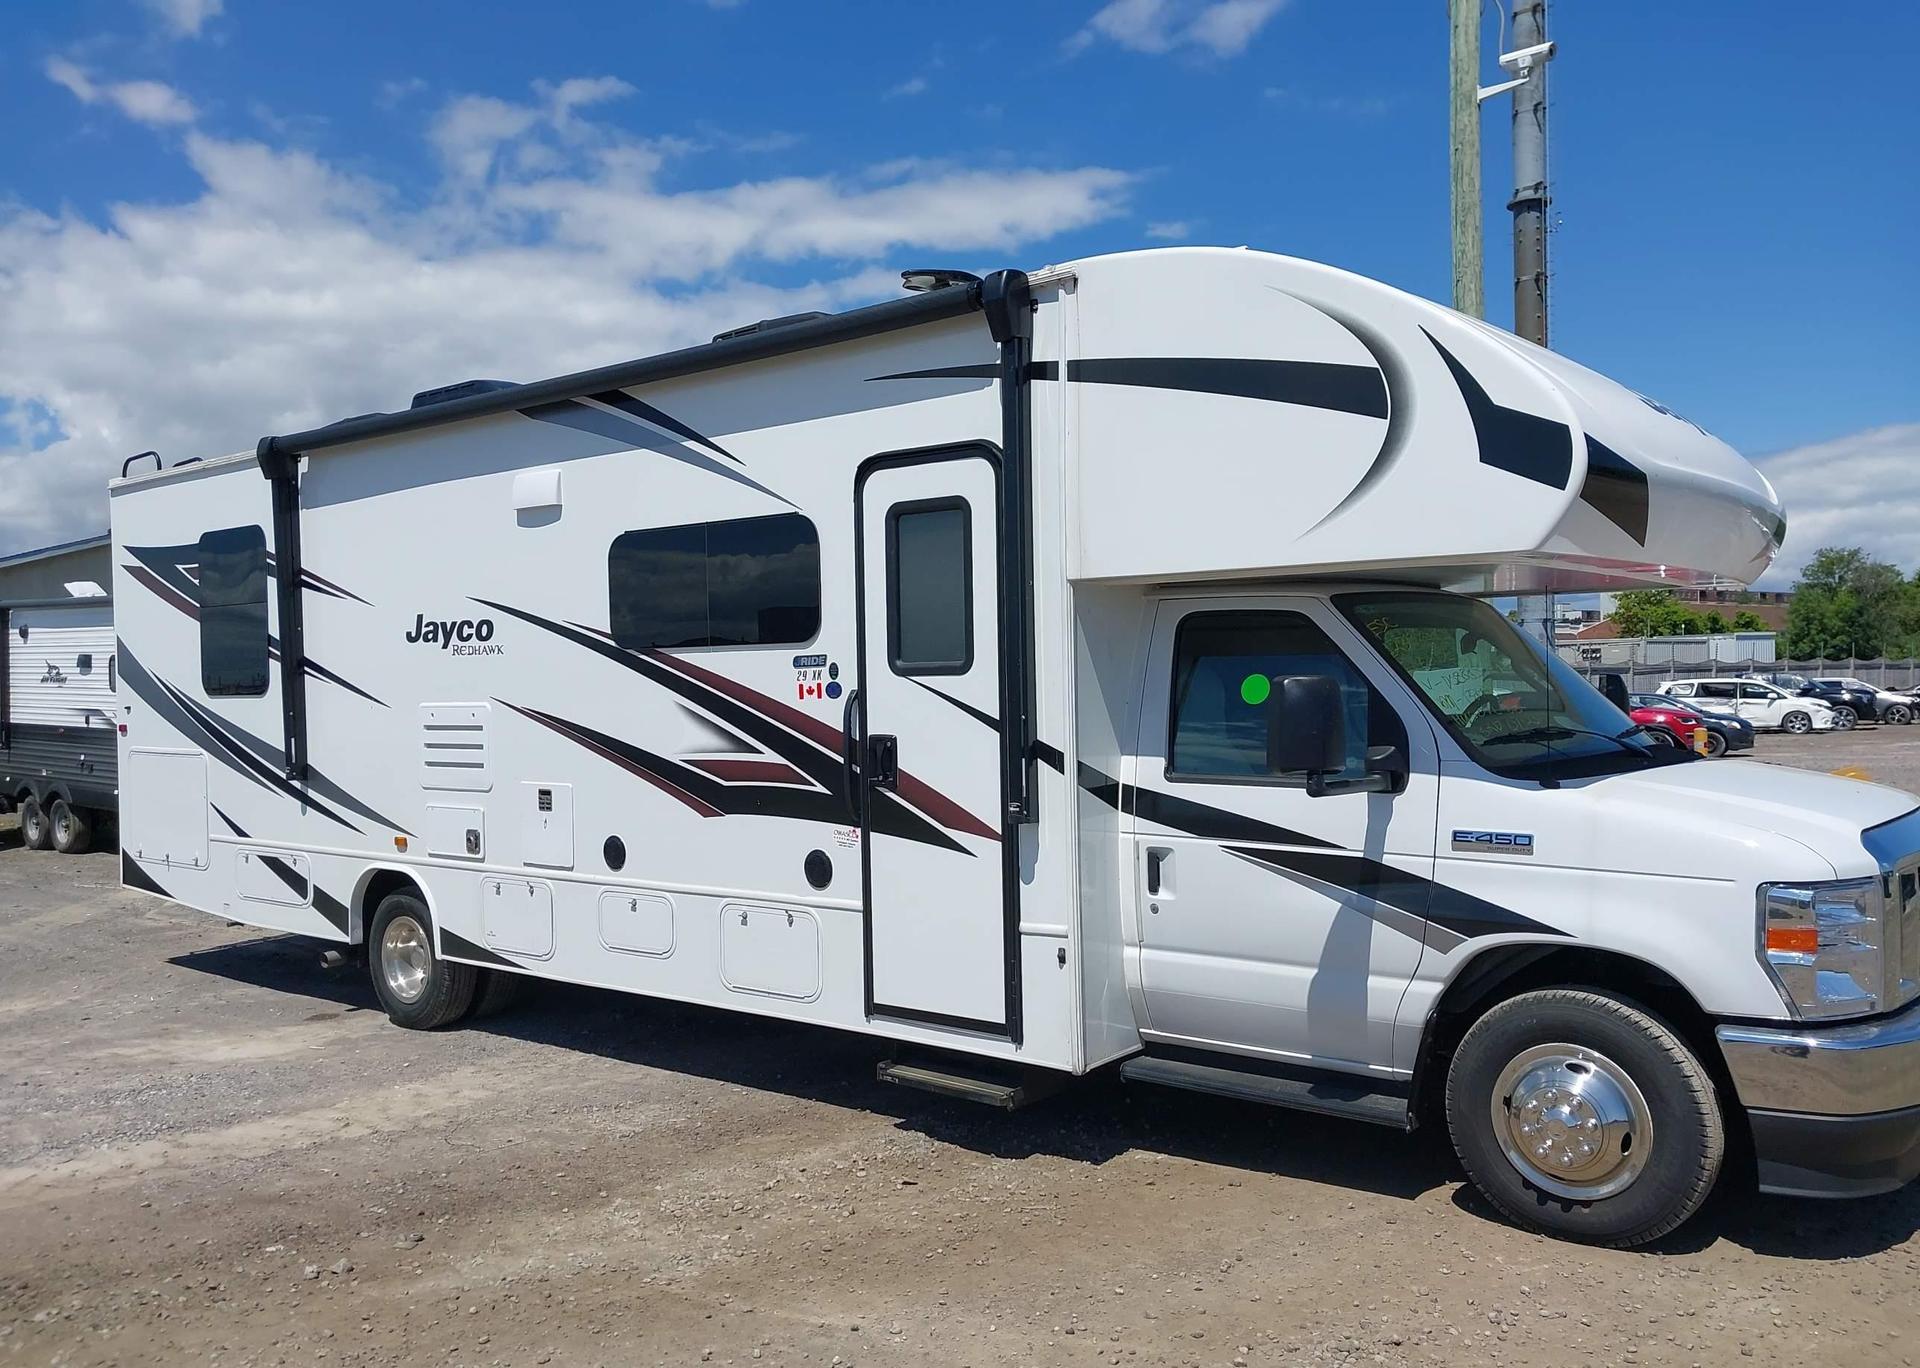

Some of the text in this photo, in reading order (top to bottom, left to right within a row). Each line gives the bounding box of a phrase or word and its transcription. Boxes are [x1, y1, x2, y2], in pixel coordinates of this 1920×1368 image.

[405, 613, 494, 649] Jayco
[452, 644, 505, 656] REDHAWK
[796, 670, 808, 681] 29
[1453, 831, 1532, 846] E-450
